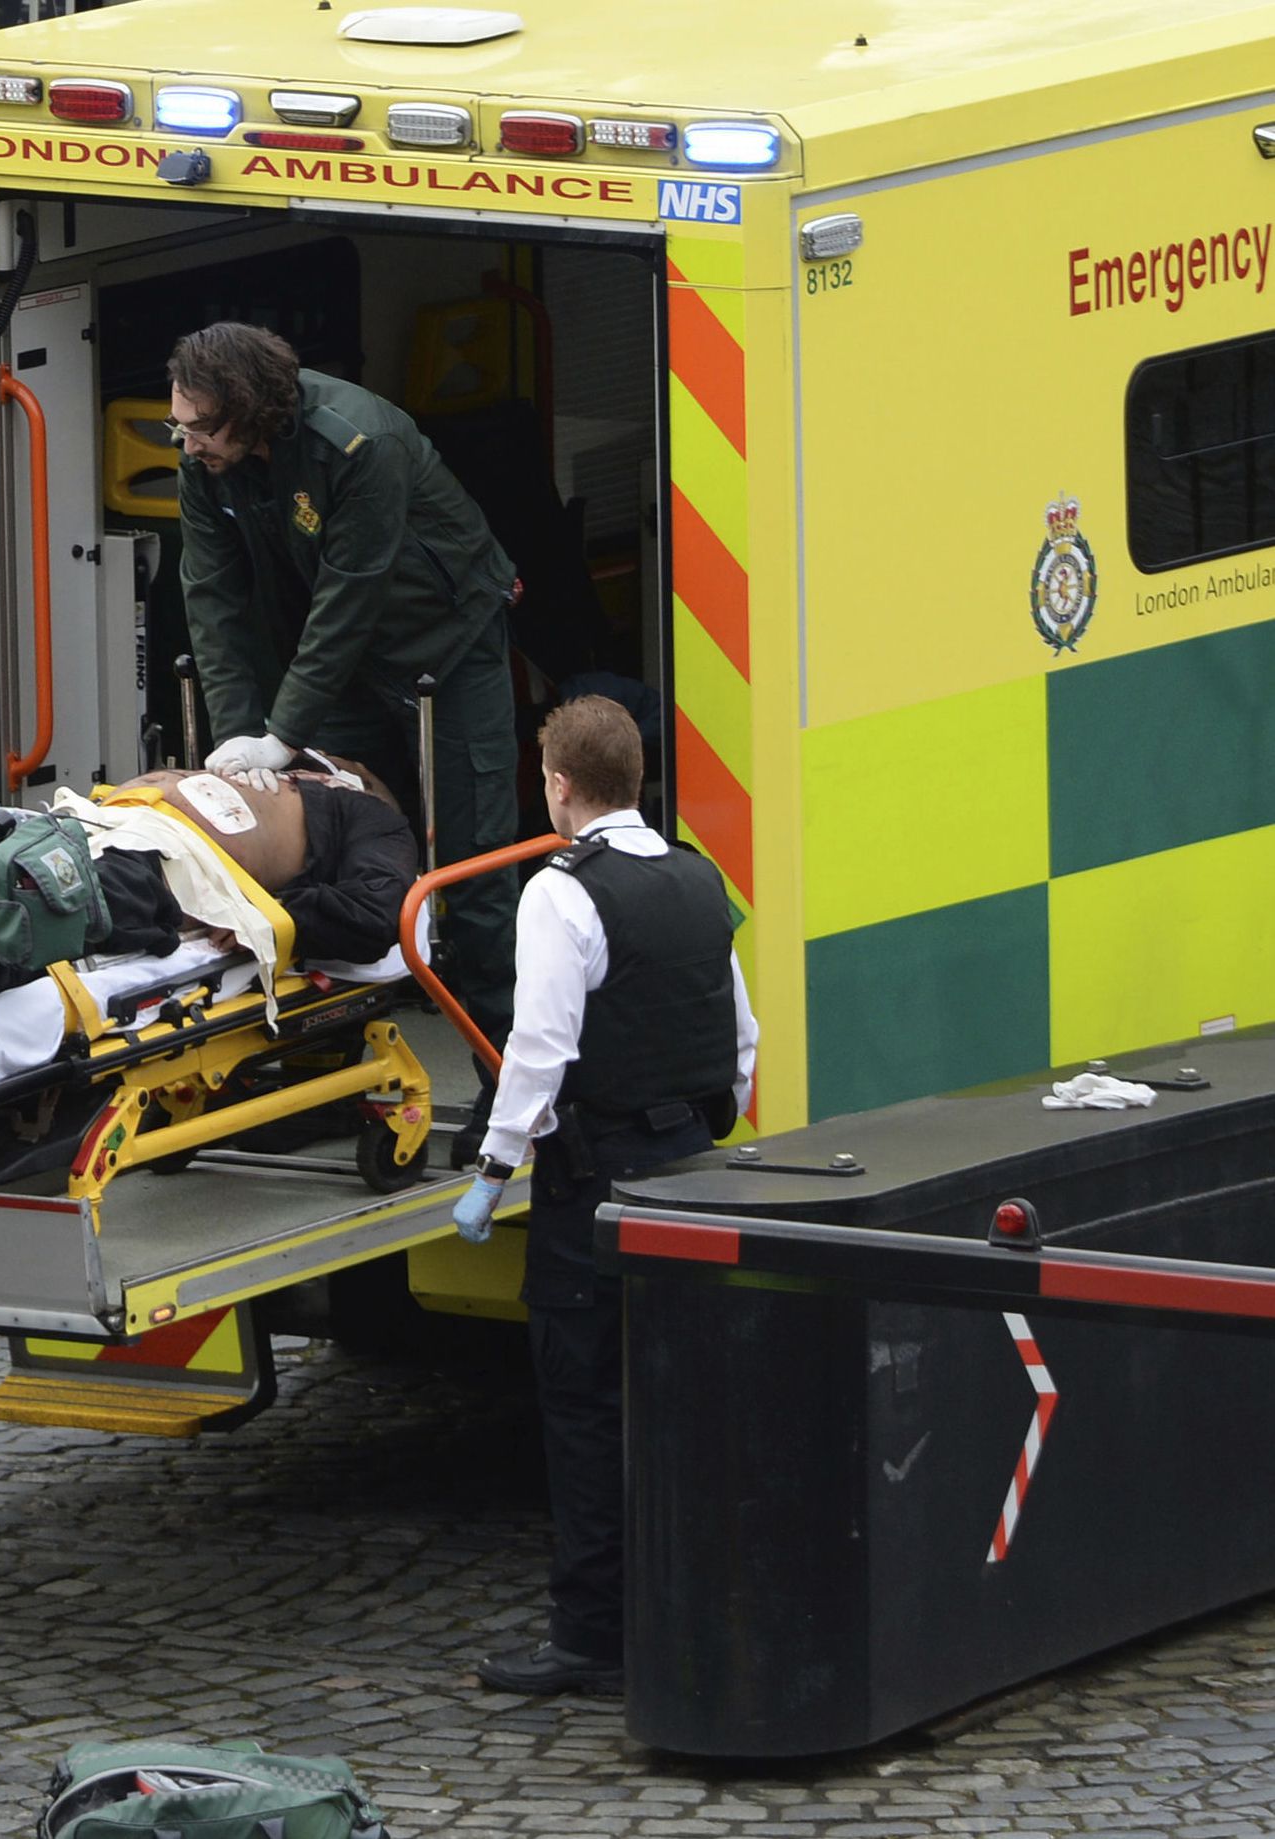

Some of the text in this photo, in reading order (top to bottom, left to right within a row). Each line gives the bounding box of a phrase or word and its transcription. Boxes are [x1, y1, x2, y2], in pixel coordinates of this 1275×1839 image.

[242, 155, 634, 203] AMBULANCE
[659, 182, 739, 222] NHS
[807, 259, 853, 295] 8132
[1068, 223, 1272, 317] Emergency
[1135, 582, 1199, 616] London
